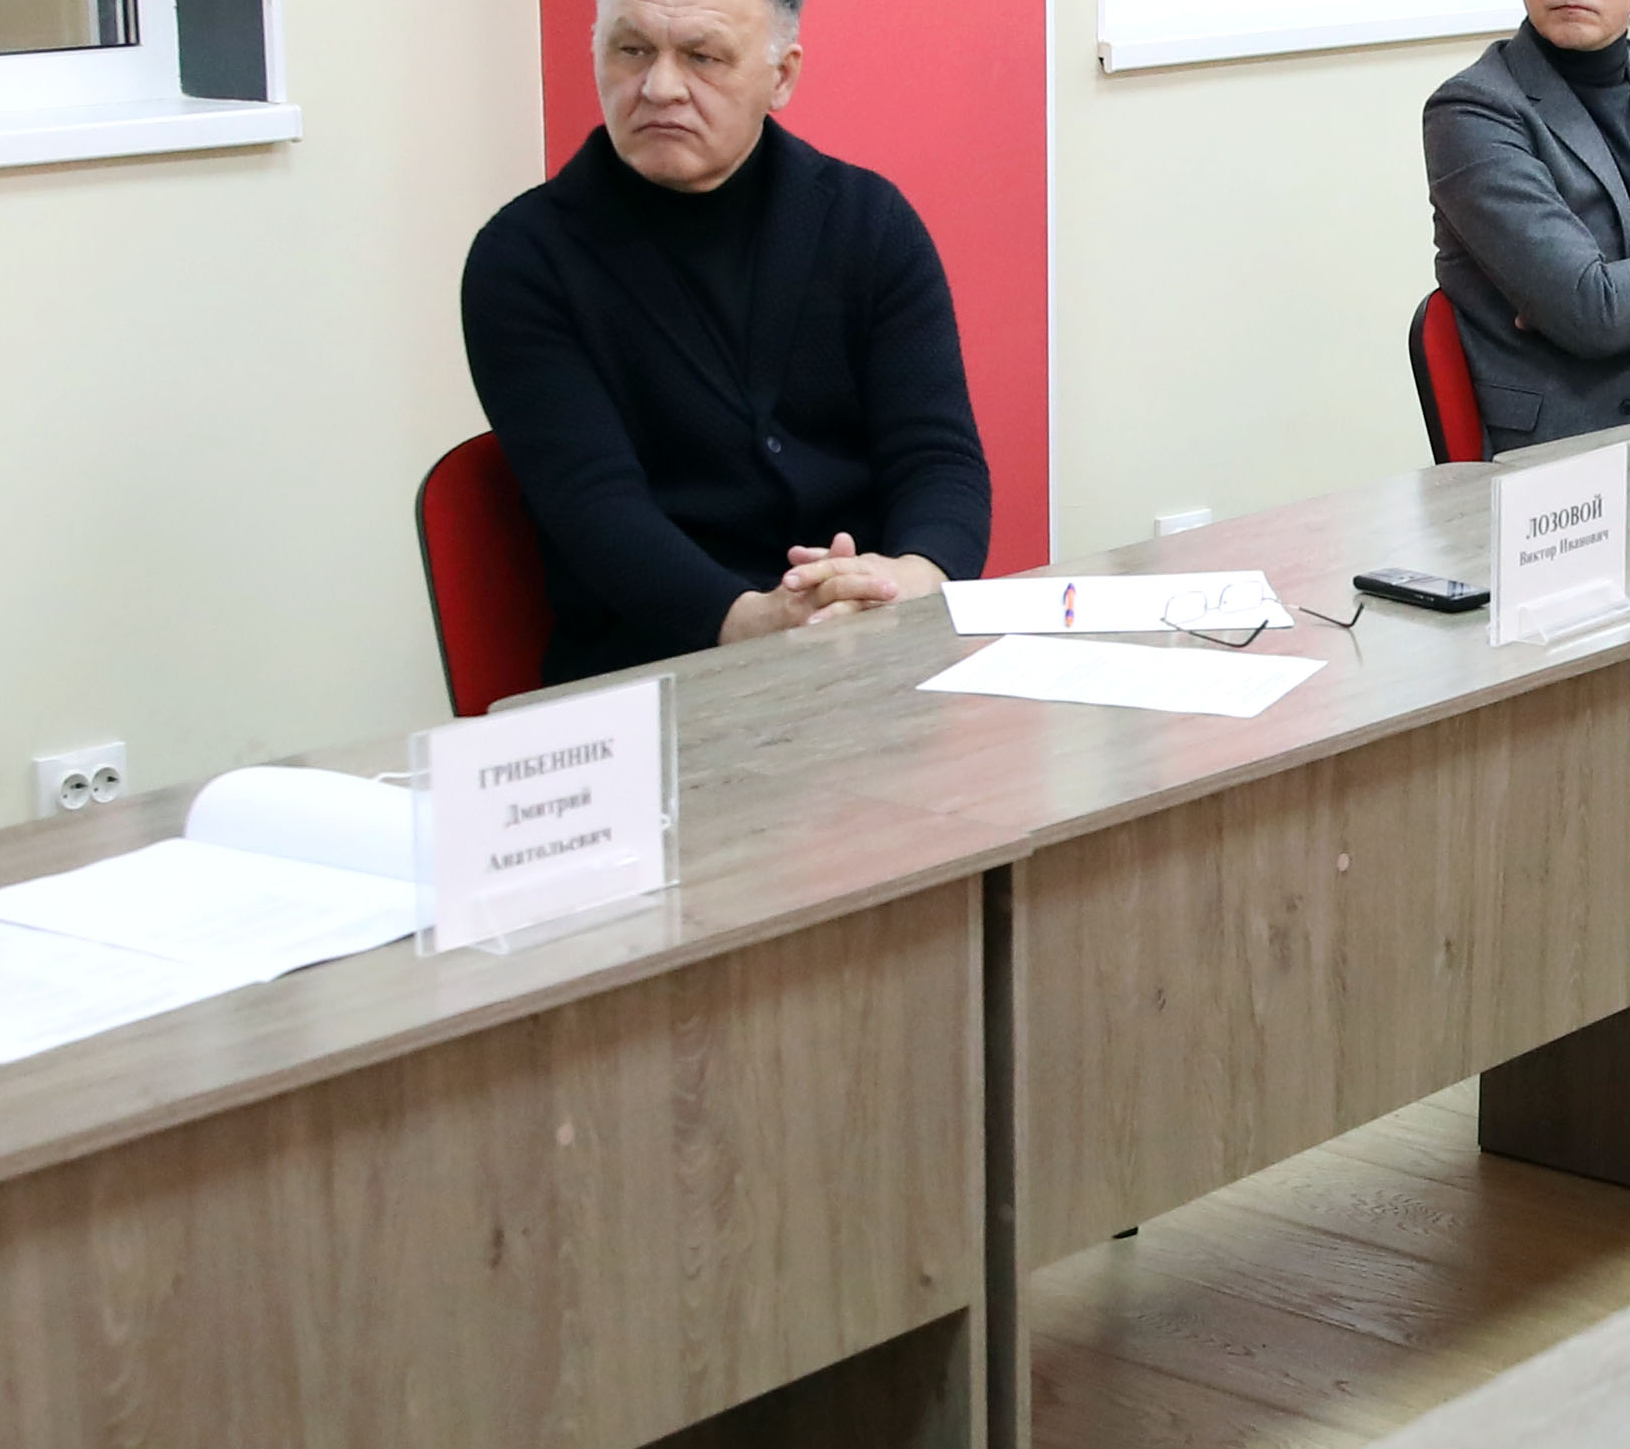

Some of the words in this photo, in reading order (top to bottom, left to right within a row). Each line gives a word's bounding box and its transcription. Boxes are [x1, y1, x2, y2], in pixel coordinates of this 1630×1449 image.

[1526, 494, 1603, 540] ЛОЗОВОЙ
[1519, 544, 1557, 567] Виктор
[1560, 529, 1609, 554] Иванович
[479, 739, 614, 789] ГРИБЕННИК
[505, 789, 592, 828] Дмитрий
[488, 828, 612, 872] Анатольевич
